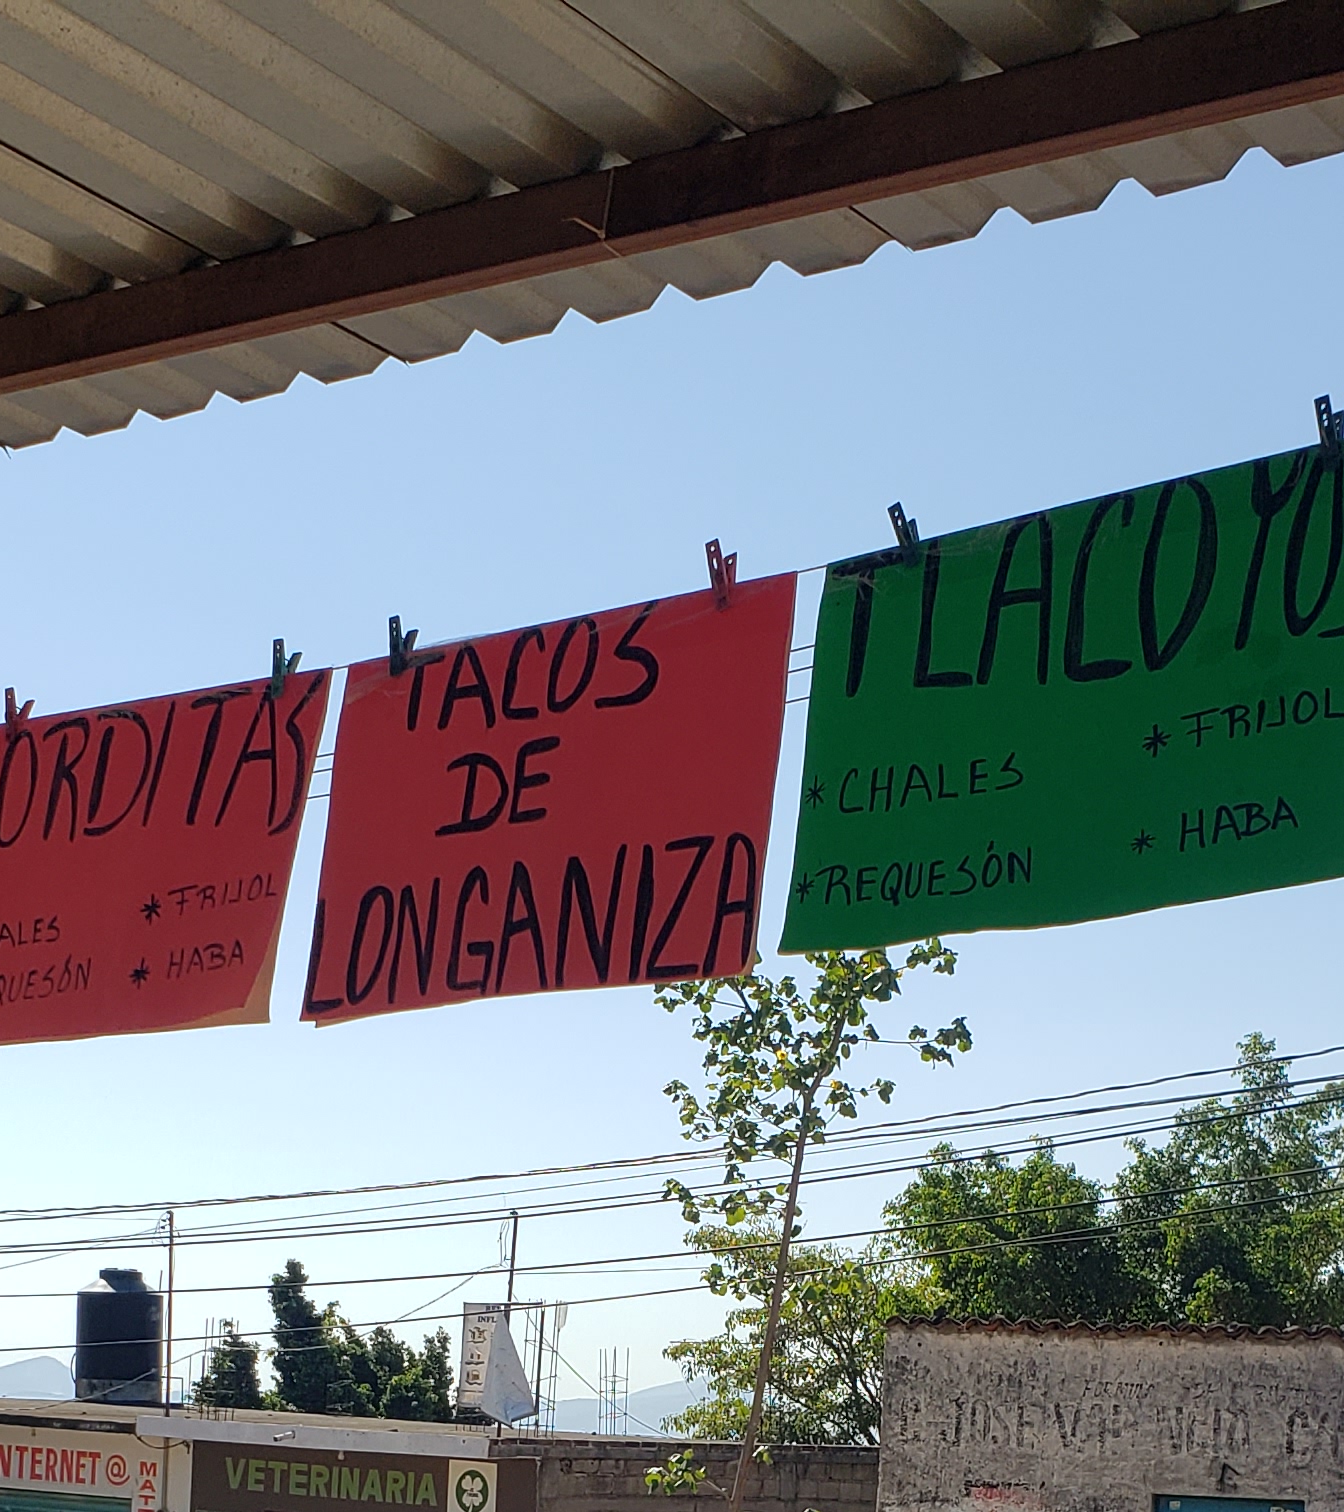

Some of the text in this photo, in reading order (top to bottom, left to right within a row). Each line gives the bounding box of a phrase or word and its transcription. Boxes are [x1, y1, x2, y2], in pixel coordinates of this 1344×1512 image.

[406, 601, 660, 731] TACOS
[436, 737, 560, 837] DE
[839, 752, 1024, 814] CHALES
[1179, 797, 1299, 852] HABA
[168, 873, 277, 916] FRIJOL
[816, 842, 1033, 906] REQUESÓN
[305, 833, 757, 1014] LONGANIZA
[168, 940, 245, 979] HABA
[225, 1457, 438, 1507] VETERINARIA
